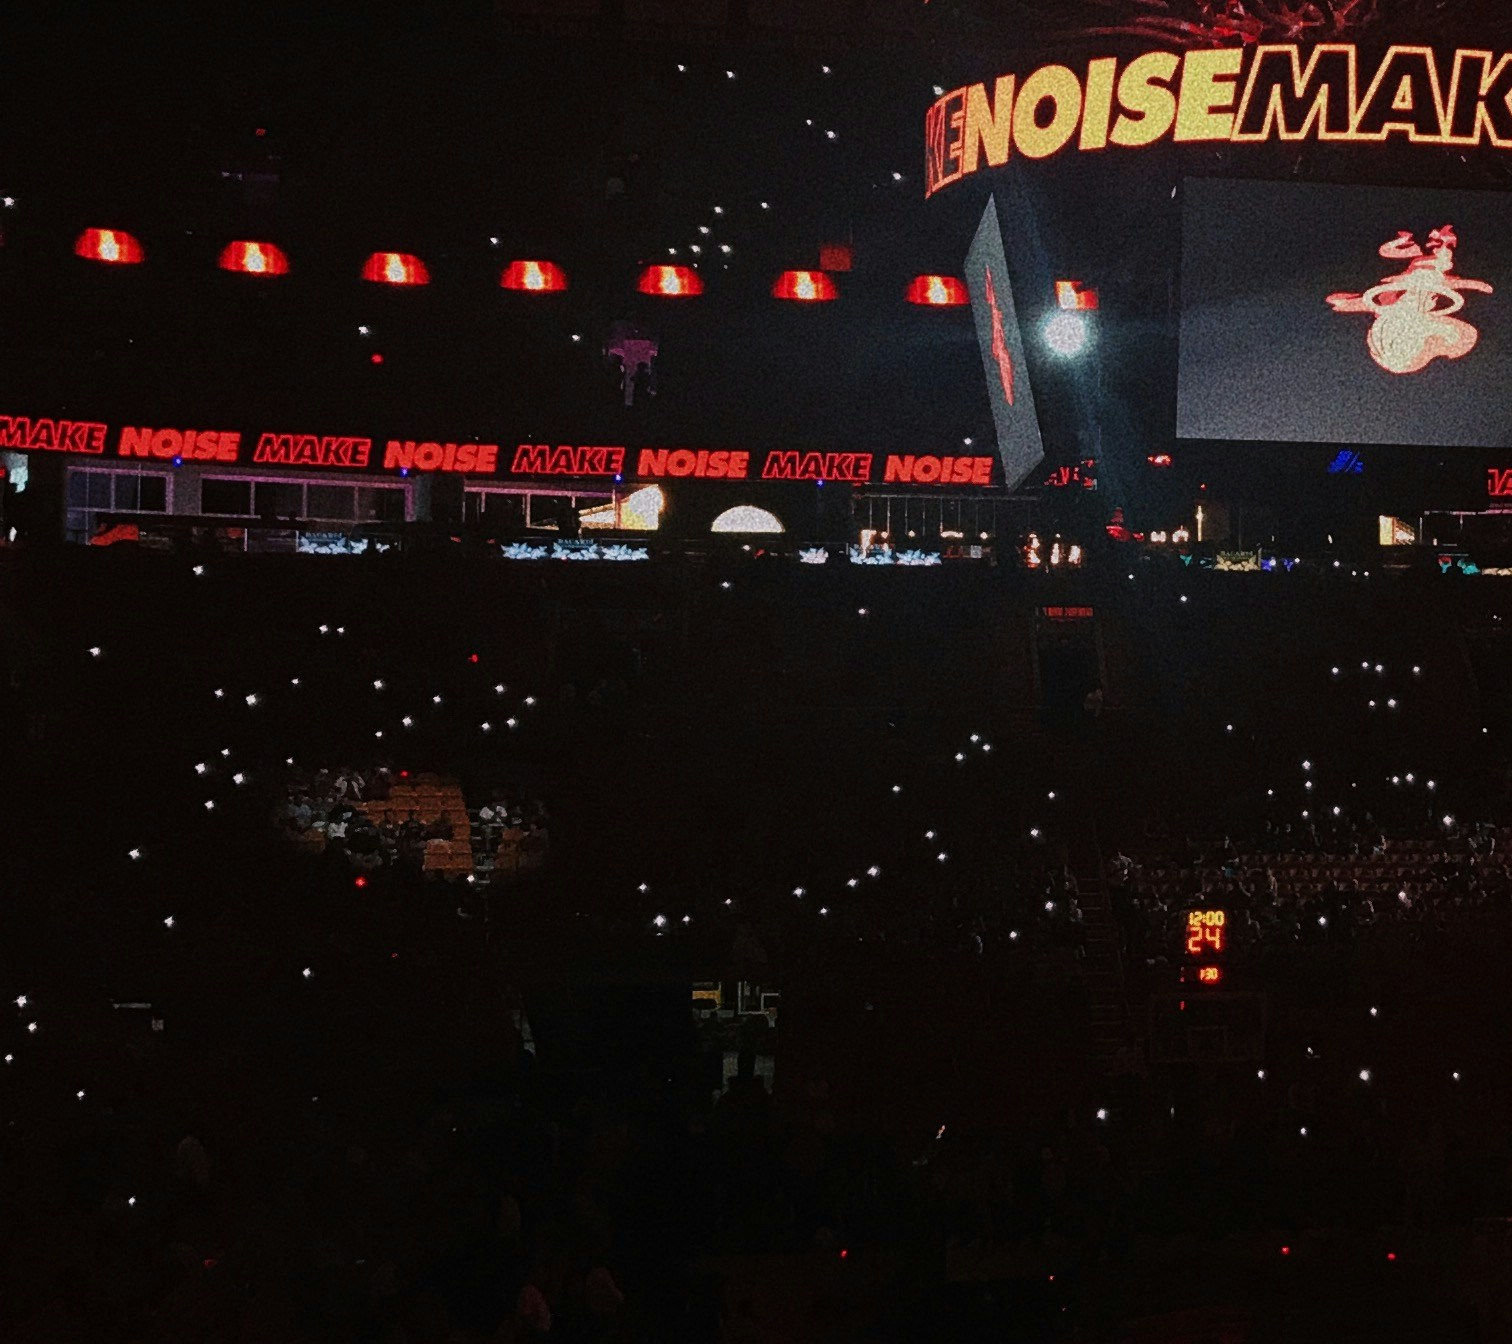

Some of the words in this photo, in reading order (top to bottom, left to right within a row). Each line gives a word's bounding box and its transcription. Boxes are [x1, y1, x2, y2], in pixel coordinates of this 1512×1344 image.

[962, 48, 1245, 174] NOISE
[0, 414, 107, 454] MAKE
[118, 426, 241, 462] NOISE
[253, 433, 372, 467] MAKE
[383, 440, 499, 473] NOISE
[511, 445, 625, 475] MAKE
[637, 449, 750, 479] NOISE
[762, 451, 872, 481] MAKE
[884, 455, 993, 485] NOISE
[1187, 926, 1221, 952] 24
